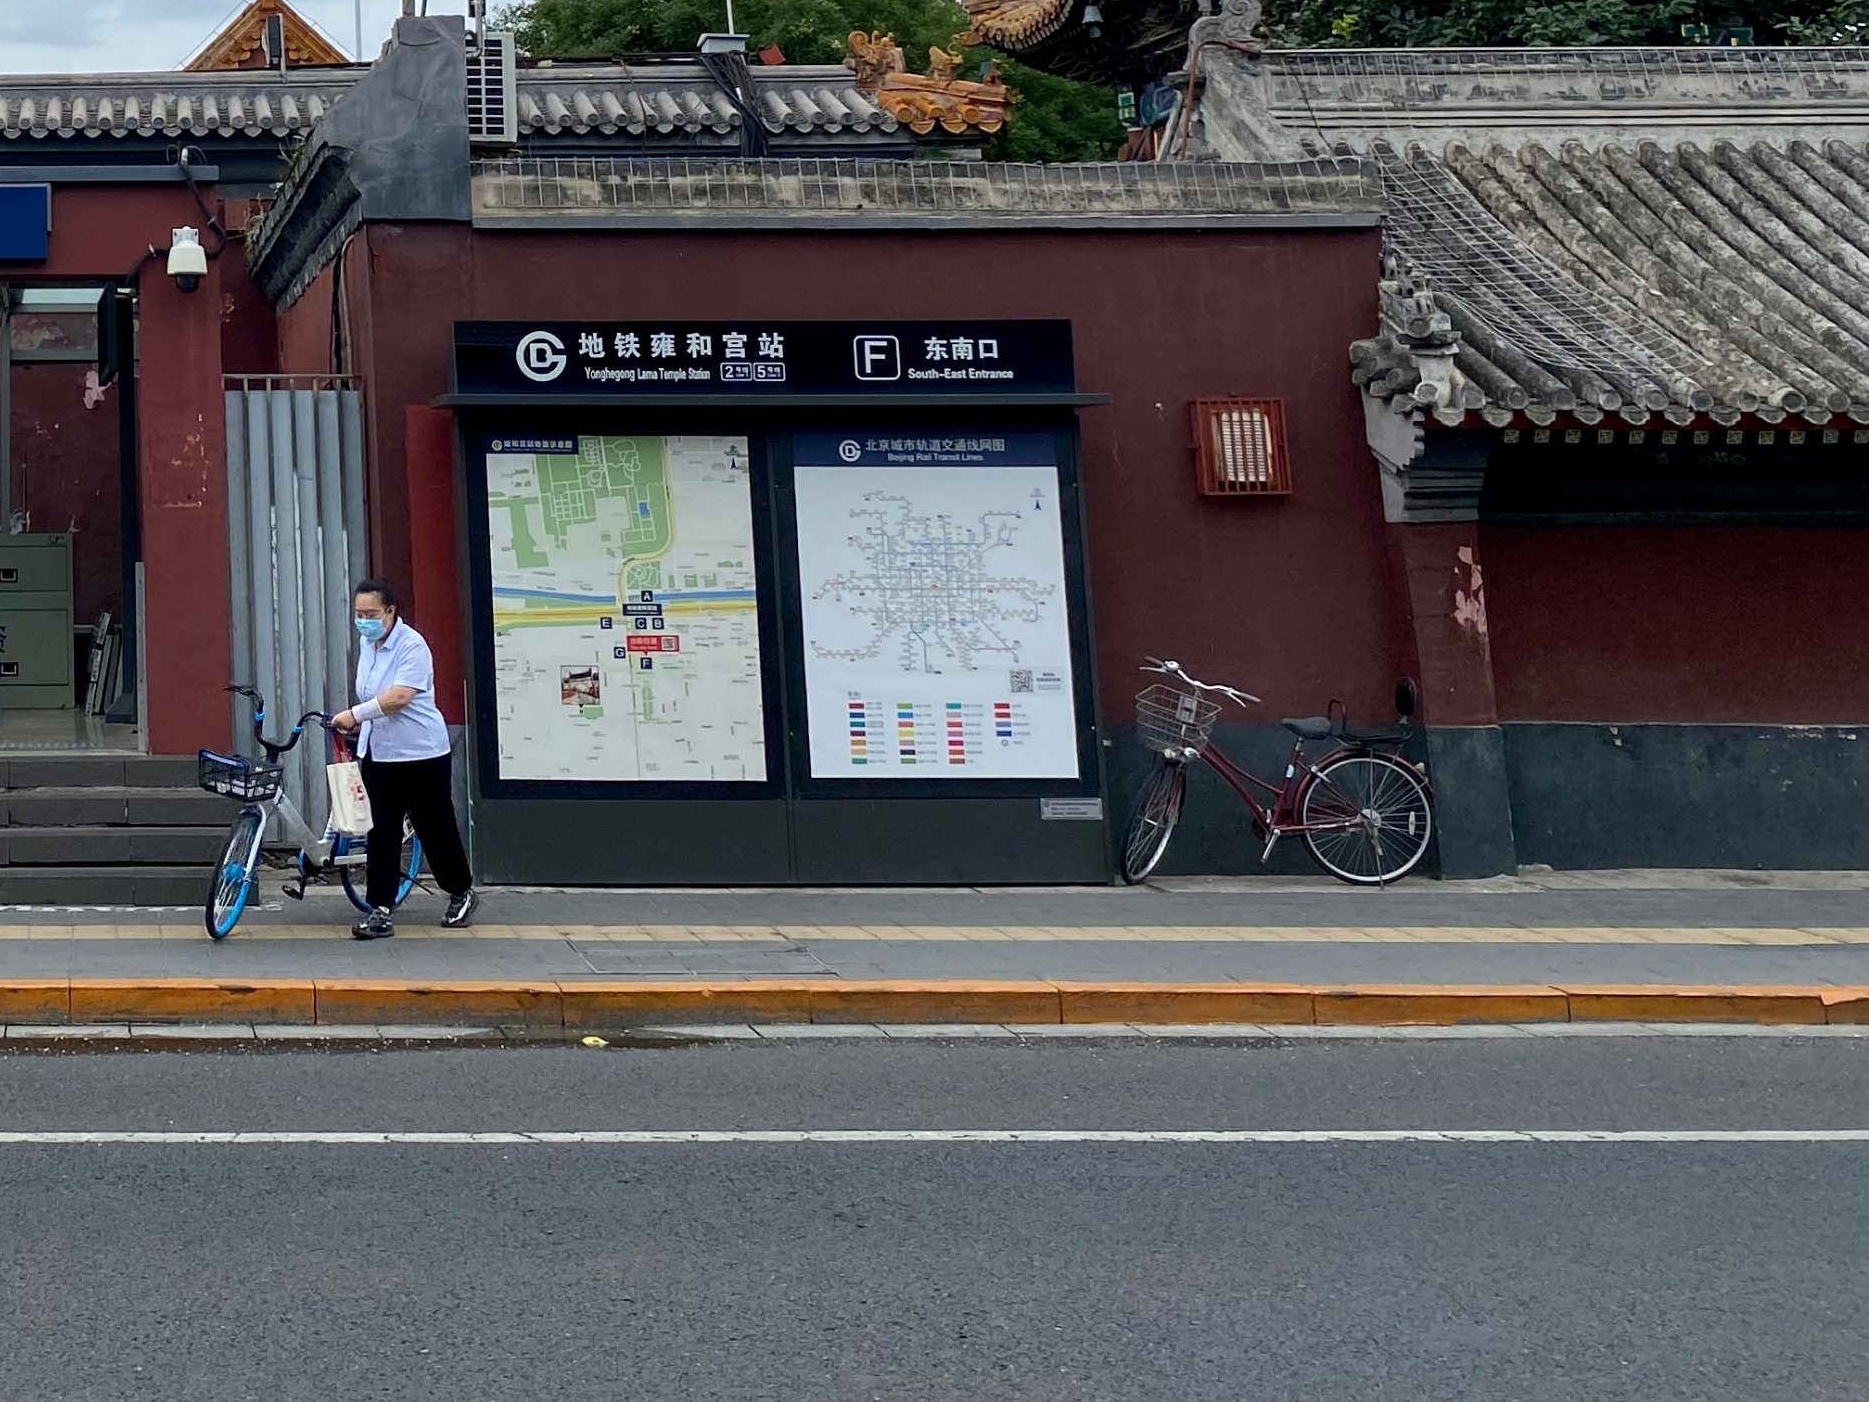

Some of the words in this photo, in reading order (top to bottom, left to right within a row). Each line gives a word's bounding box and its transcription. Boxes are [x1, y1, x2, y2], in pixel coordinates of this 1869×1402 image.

[578, 332, 785, 359] 地铁雍和宫站
[924, 336, 999, 361] 东南口
[864, 340, 888, 373] F
[584, 366, 636, 382] Yonghegong
[637, 367, 658, 380] Lama
[658, 367, 687, 382] Temple
[688, 367, 711, 381] Station
[908, 367, 967, 379] South-East
[968, 367, 1014, 379] Entrance
[865, 438, 1005, 452] 北京城市轨道交通线网图
[887, 453, 914, 463] Beijing
[916, 453, 931, 462] Rail
[933, 452, 960, 462] Transit
[961, 452, 984, 462] Lines
[643, 592, 651, 601] A
[602, 619, 610, 627] E
[637, 619, 645, 628] C
[654, 619, 662, 628] B
[615, 648, 624, 657] G
[642, 659, 650, 668] F
